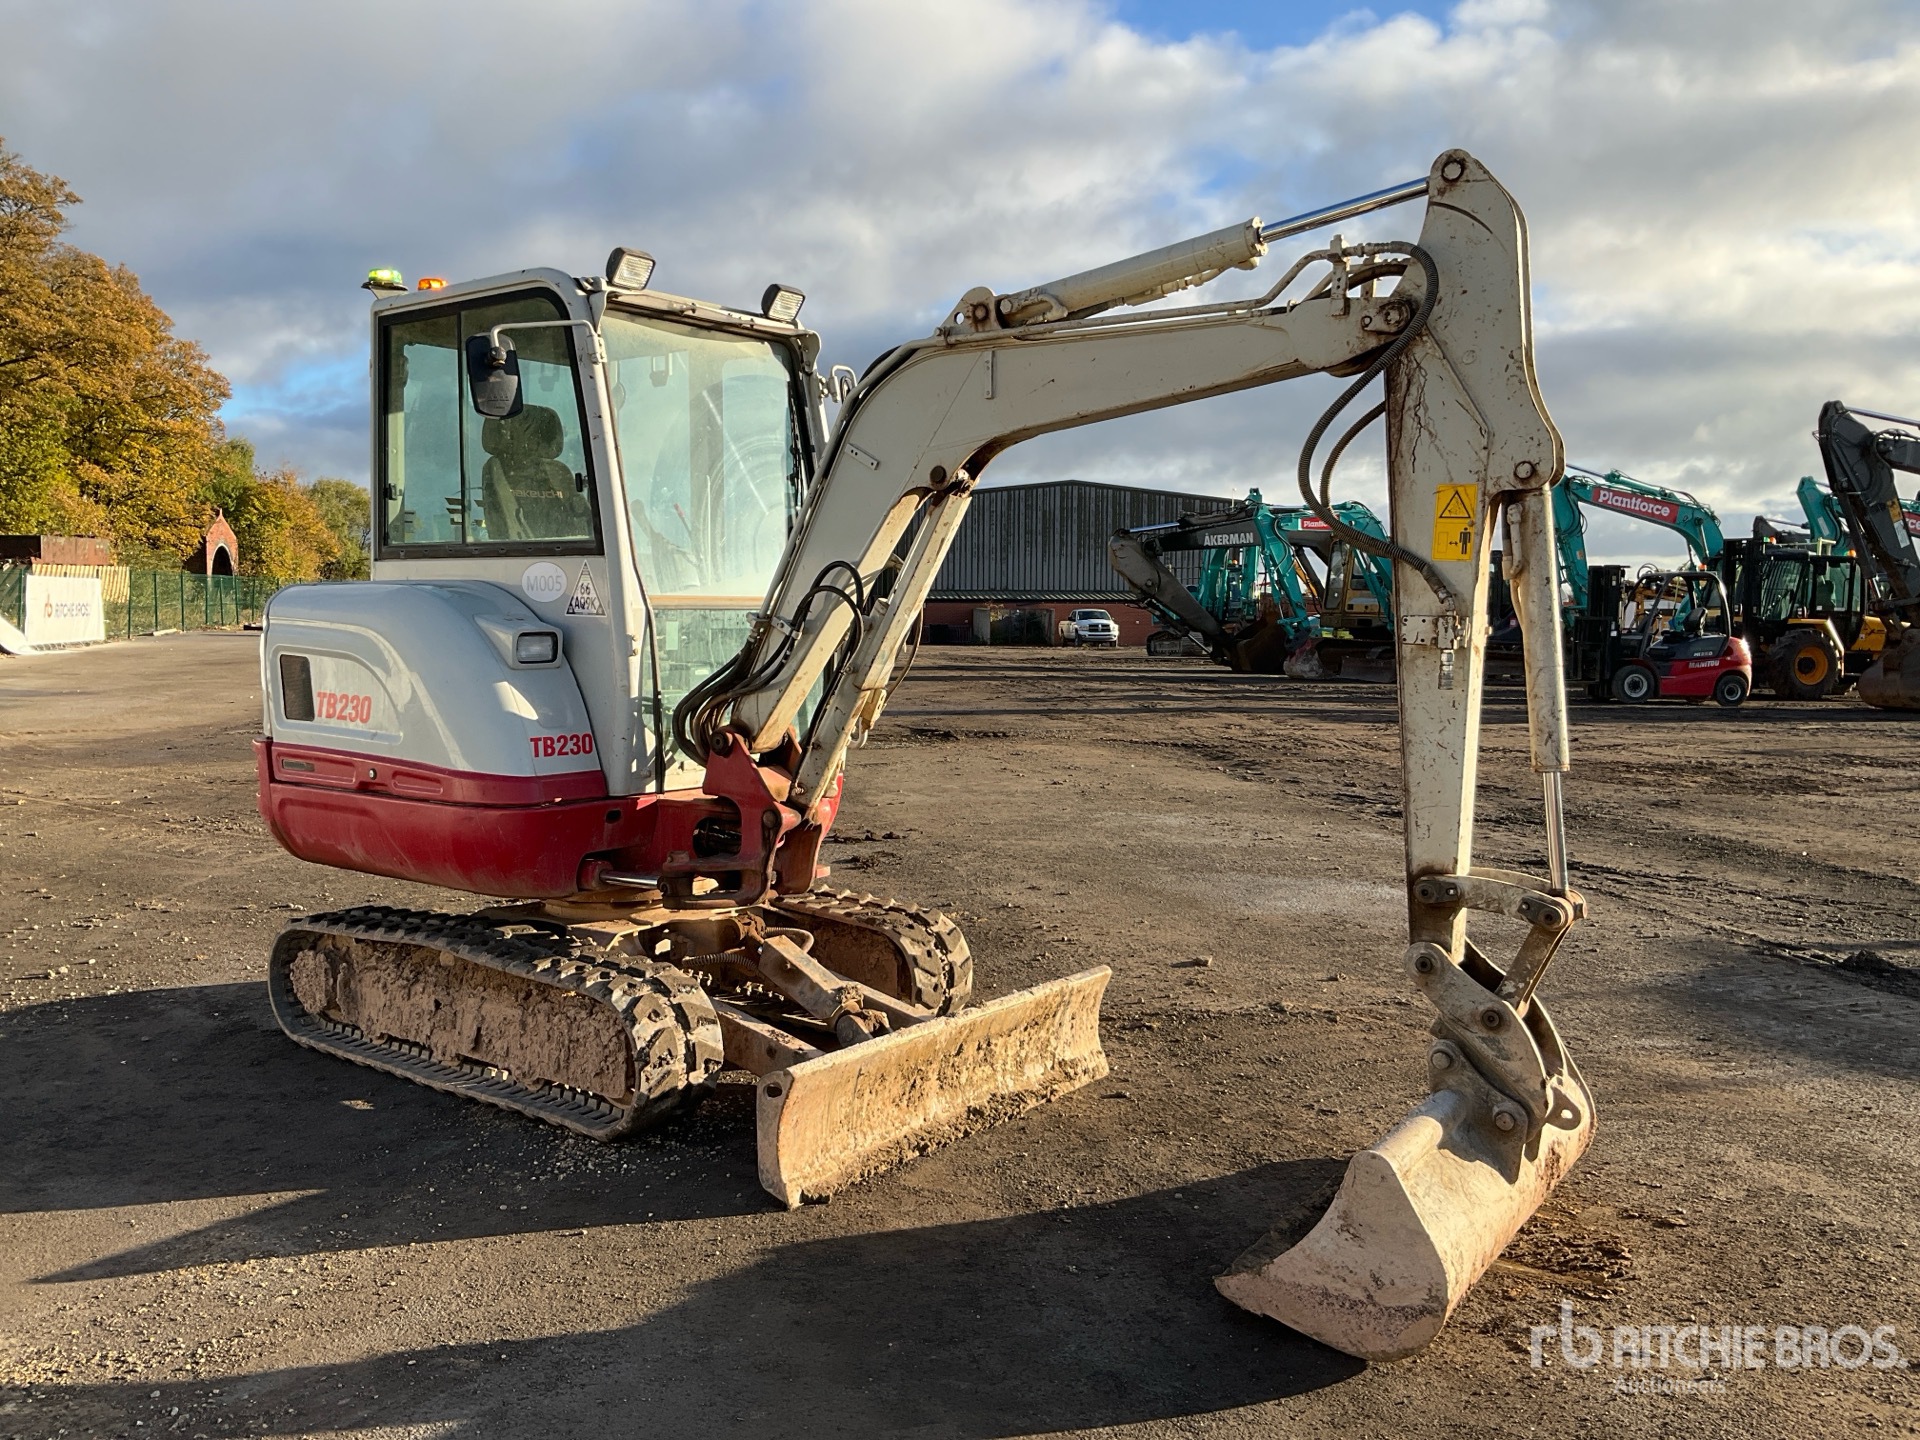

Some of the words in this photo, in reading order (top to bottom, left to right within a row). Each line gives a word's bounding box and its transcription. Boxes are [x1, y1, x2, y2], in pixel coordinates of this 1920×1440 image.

[1599, 490, 1670, 517] Plantforce
[1203, 532, 1254, 546] ÅKERMAN
[526, 575, 562, 592] M005
[317, 691, 372, 724] TB230
[529, 733, 593, 758] TB230
